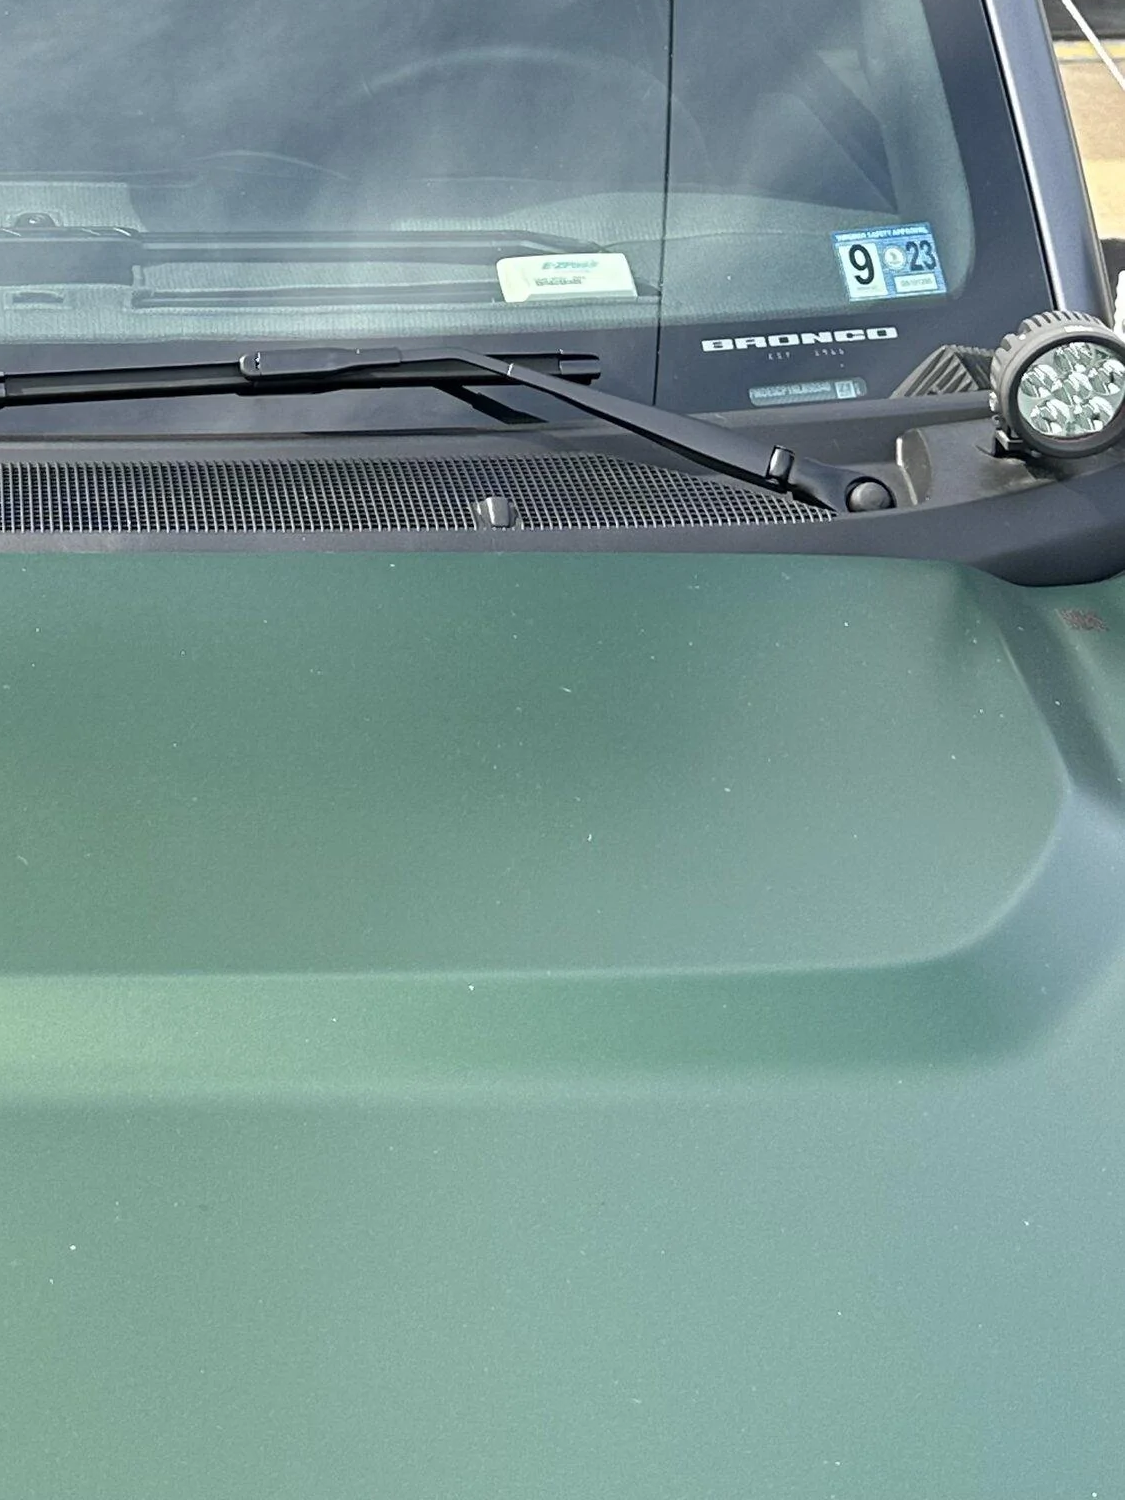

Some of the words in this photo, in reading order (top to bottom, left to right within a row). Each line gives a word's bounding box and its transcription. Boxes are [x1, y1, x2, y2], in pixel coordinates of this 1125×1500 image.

[848, 243, 875, 286] 9
[905, 239, 937, 271] 23
[701, 326, 899, 353] BRONCO
